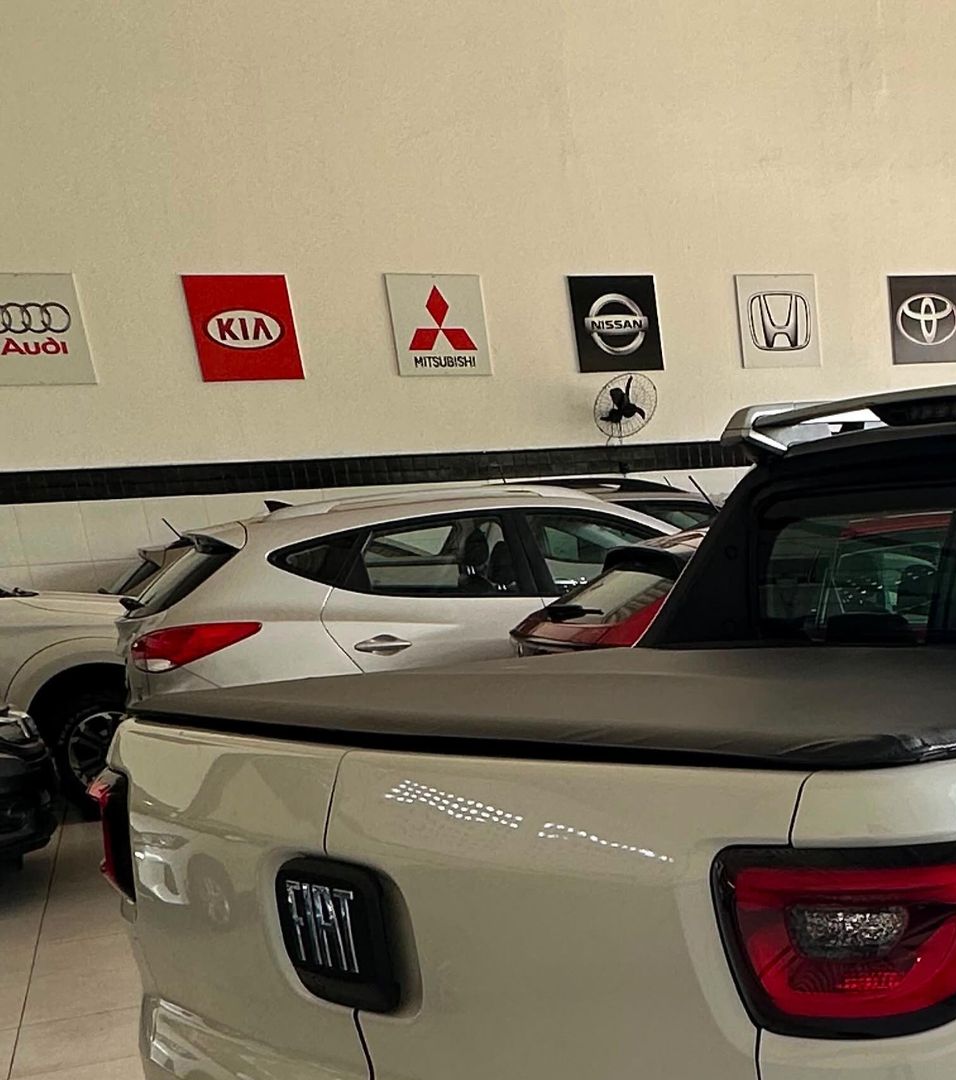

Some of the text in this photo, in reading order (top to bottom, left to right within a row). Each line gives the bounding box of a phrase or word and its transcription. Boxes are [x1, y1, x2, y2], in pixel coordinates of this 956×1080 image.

[216, 318, 274, 341] KIA
[590, 319, 644, 330] NISSAN
[1, 336, 69, 355] Audi
[413, 355, 477, 369] MITSUBISHI
[285, 879, 360, 974] FIAT
